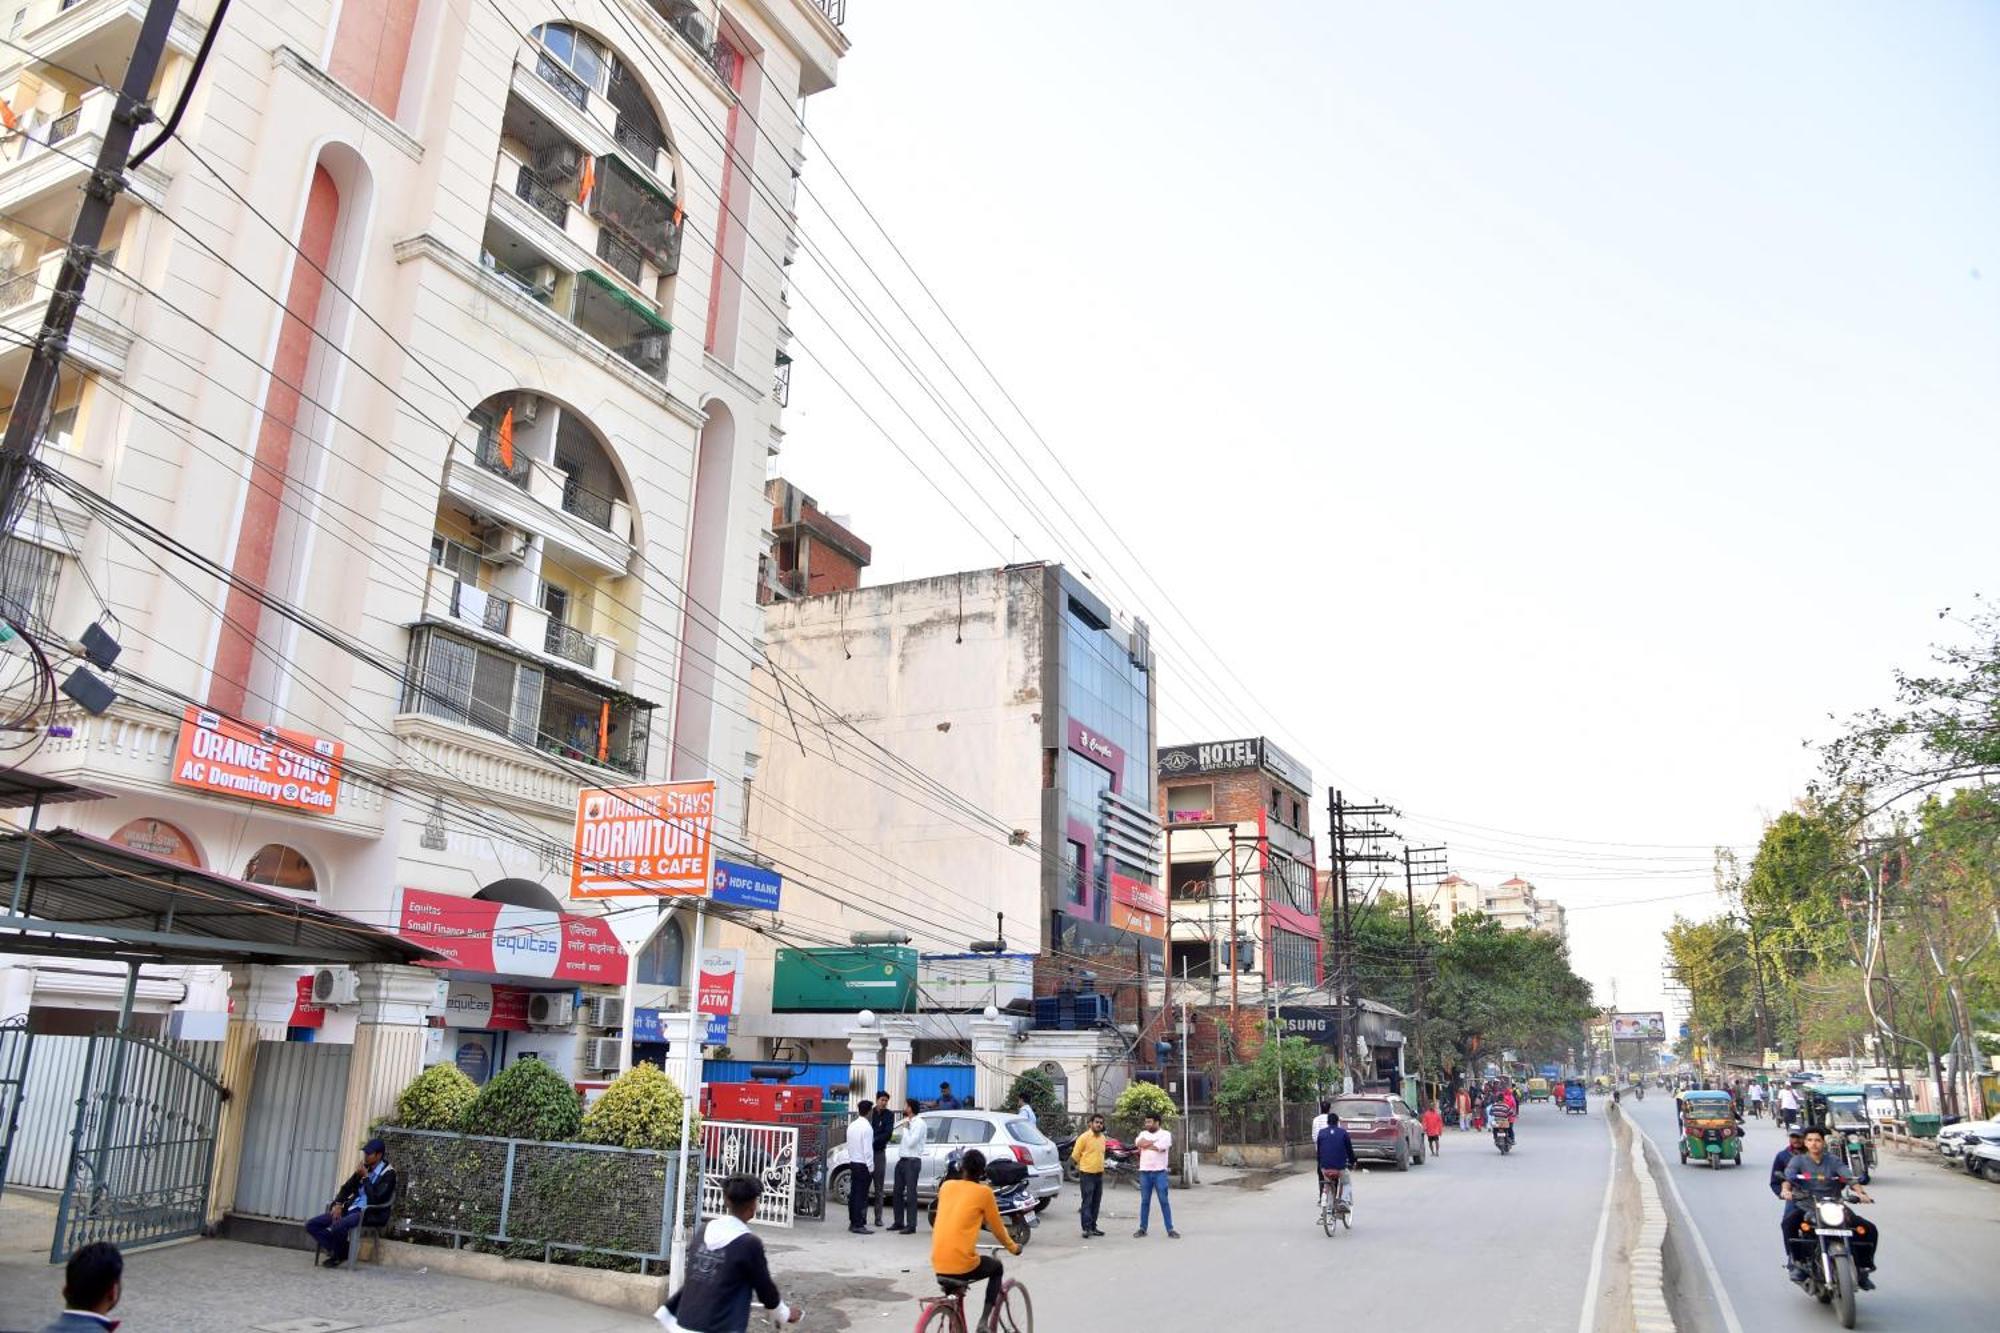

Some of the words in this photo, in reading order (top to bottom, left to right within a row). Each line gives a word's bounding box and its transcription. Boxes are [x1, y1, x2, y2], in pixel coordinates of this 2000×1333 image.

[191, 728, 273, 772] ORANGE
[277, 748, 331, 785] STAYS
[1200, 740, 1257, 765] HOTEL
[181, 760, 205, 781] AC
[208, 766, 282, 801] Dormitory
[299, 786, 333, 807] Cafe
[606, 795, 662, 818] ORANGE
[668, 791, 711, 814] STAYS
[582, 815, 710, 859] DORMITORY
[640, 860, 651, 874] &
[657, 857, 703, 874] CAFE
[729, 875, 753, 890] HDFC
[754, 881, 778, 895] BANK
[409, 901, 442, 915] Equitas
[407, 919, 432, 932] Small
[433, 923, 465, 936] Finance
[467, 927, 488, 938] Bank
[496, 932, 558, 955] equitas
[447, 997, 490, 1013] equitas
[701, 994, 728, 1007] ATM
[707, 1024, 726, 1034] ANK
